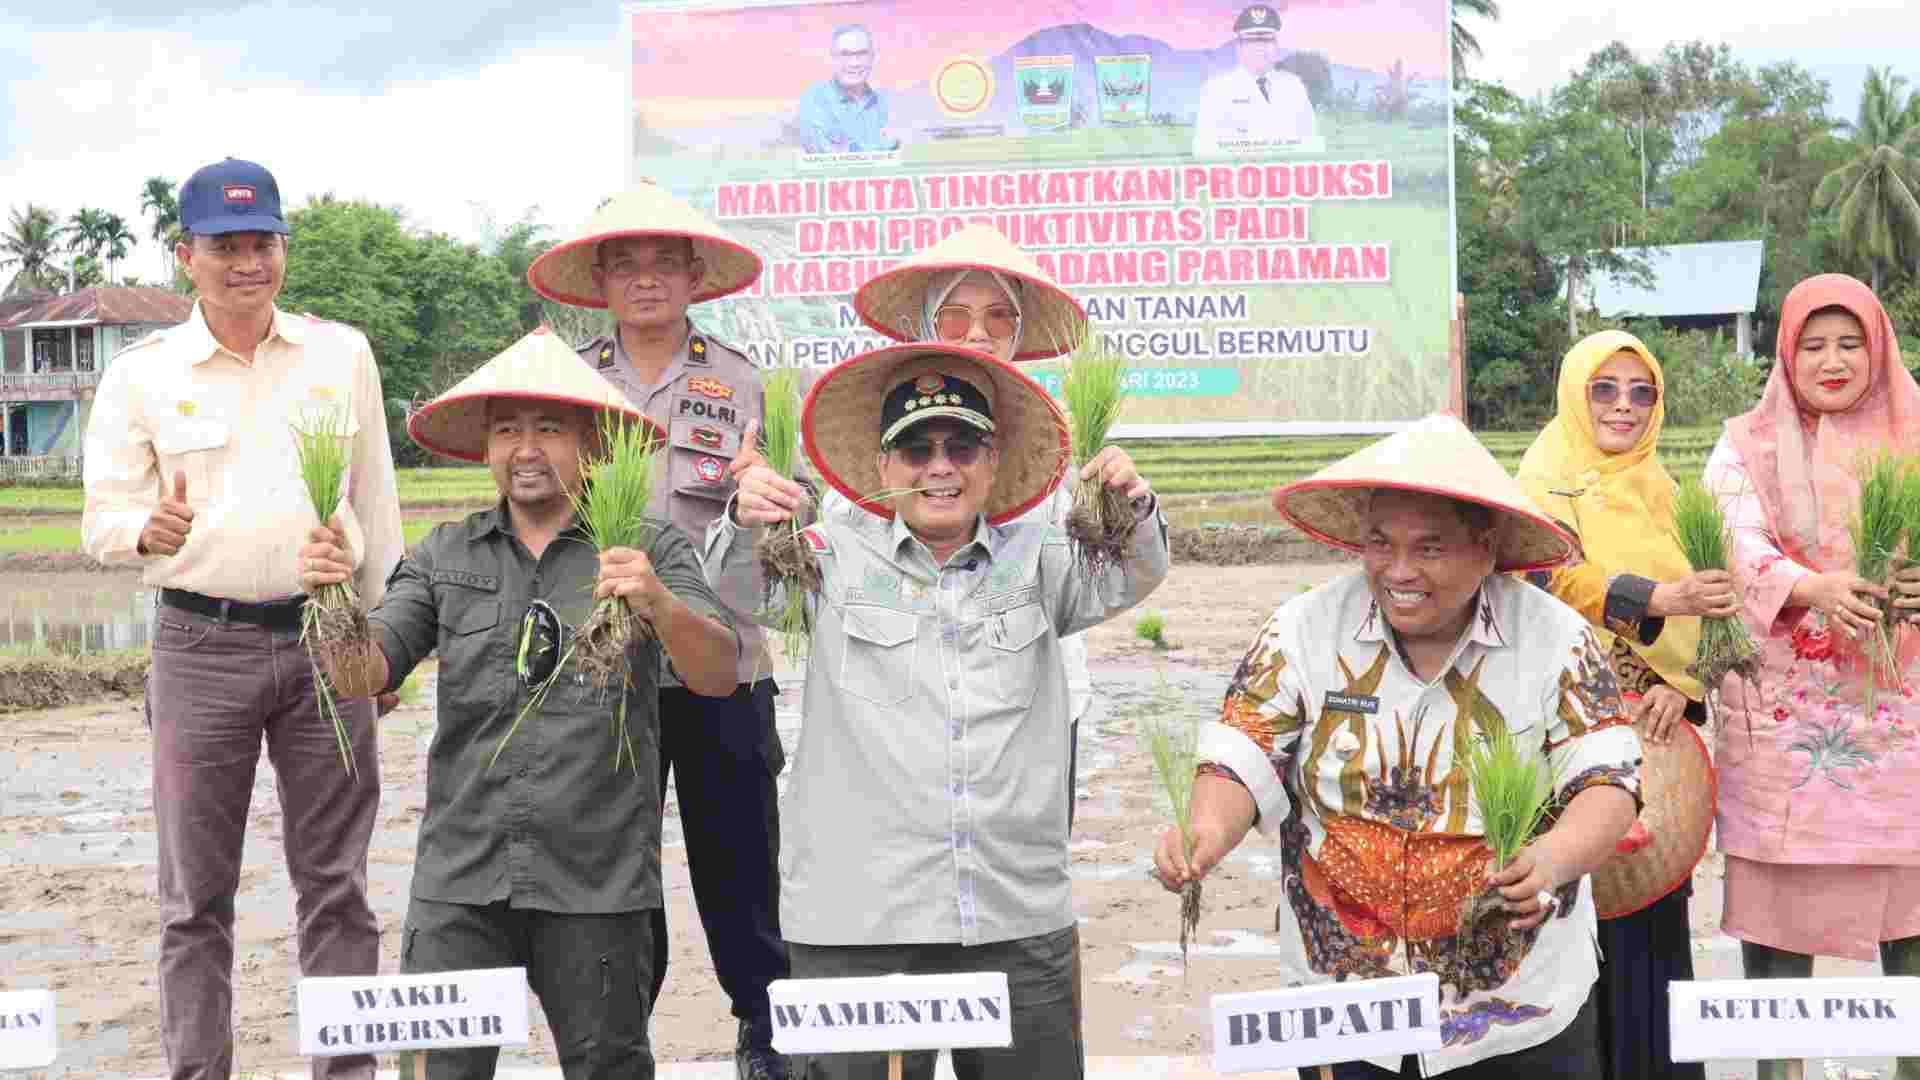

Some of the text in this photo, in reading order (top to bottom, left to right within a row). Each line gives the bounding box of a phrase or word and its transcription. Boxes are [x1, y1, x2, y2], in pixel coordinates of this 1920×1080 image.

[717, 160, 1391, 216] MARI KITA TINGKATKAN PRODUKSI
[798, 206, 1305, 252] DAN PROUKTIVITAS PADI
[1035, 249, 1167, 285] ADANG
[1177, 245, 1389, 282] PARIAMAN
[1134, 293, 1246, 320] TANAM
[1102, 331, 1209, 356] NGGUL
[1217, 329, 1369, 355] BERMUTU
[1152, 369, 1200, 389] 2023
[680, 399, 736, 424] POLRI
[351, 984, 468, 1011] WAKIL
[773, 996, 1001, 1028] WAMENTAN
[1699, 997, 1898, 1021] KETUA PKK
[318, 1014, 504, 1048] GUBERNUR
[1227, 997, 1424, 1047] BUPATI
